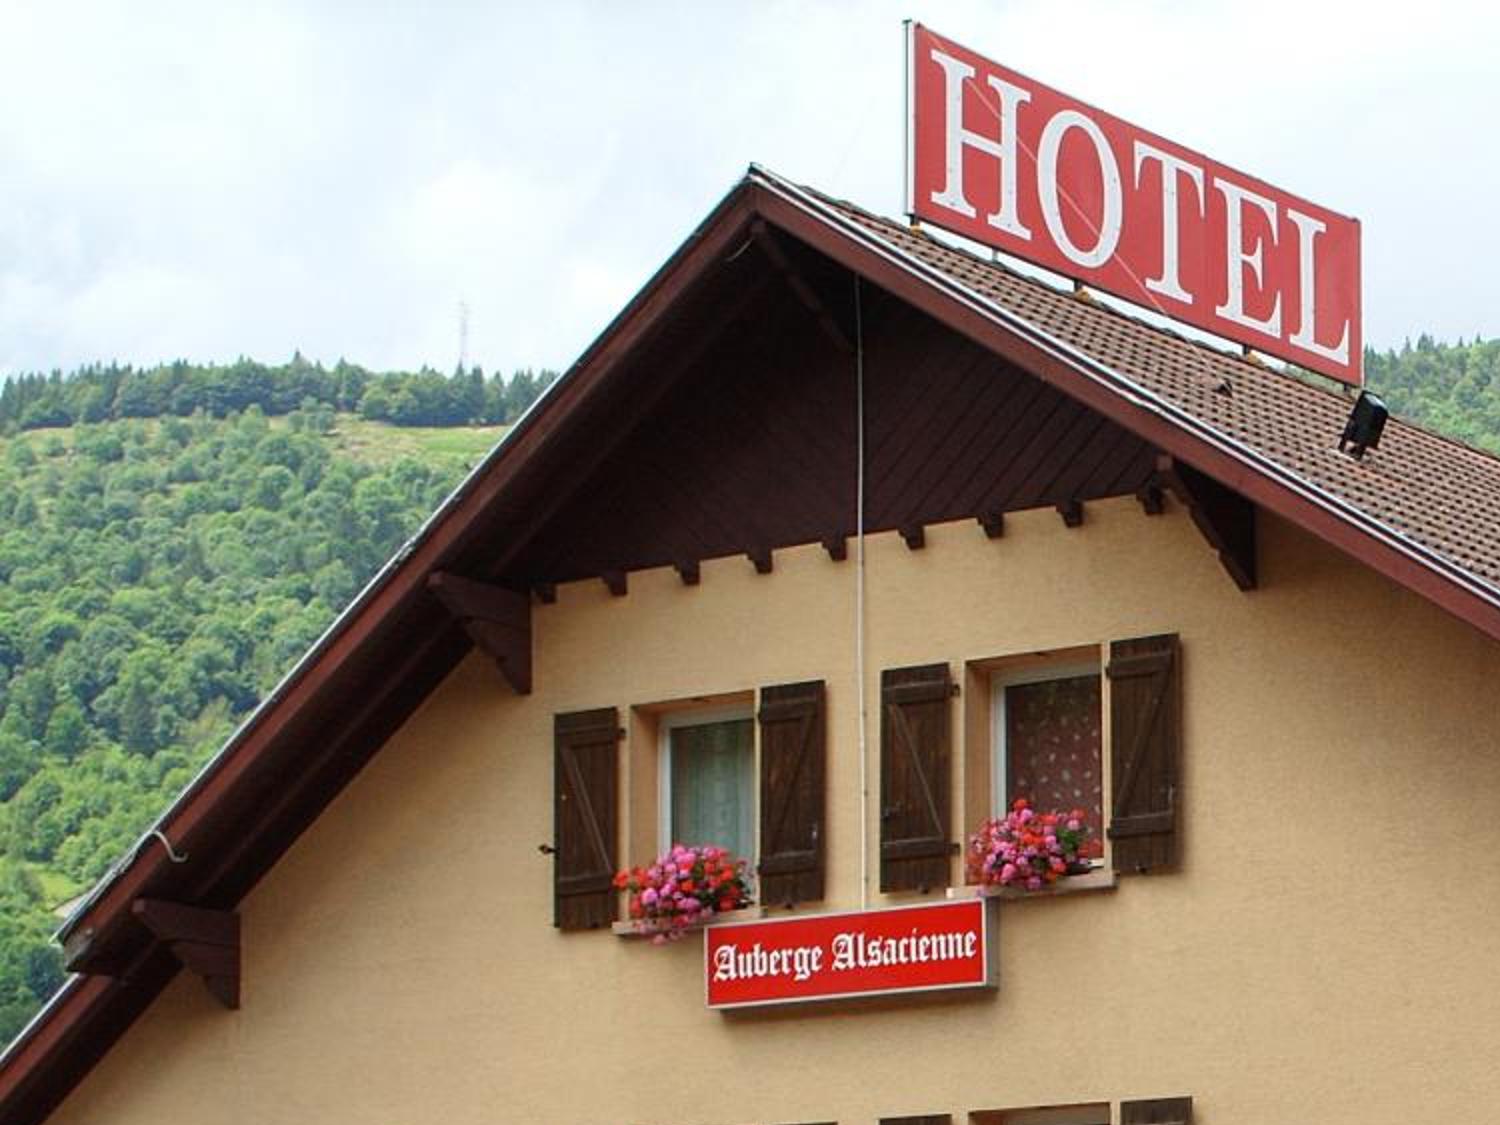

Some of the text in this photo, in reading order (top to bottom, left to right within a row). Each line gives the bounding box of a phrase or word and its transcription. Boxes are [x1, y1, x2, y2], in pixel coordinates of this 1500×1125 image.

[930, 48, 1350, 367] HOTEL
[713, 927, 977, 981] Auberge Alsacienne
